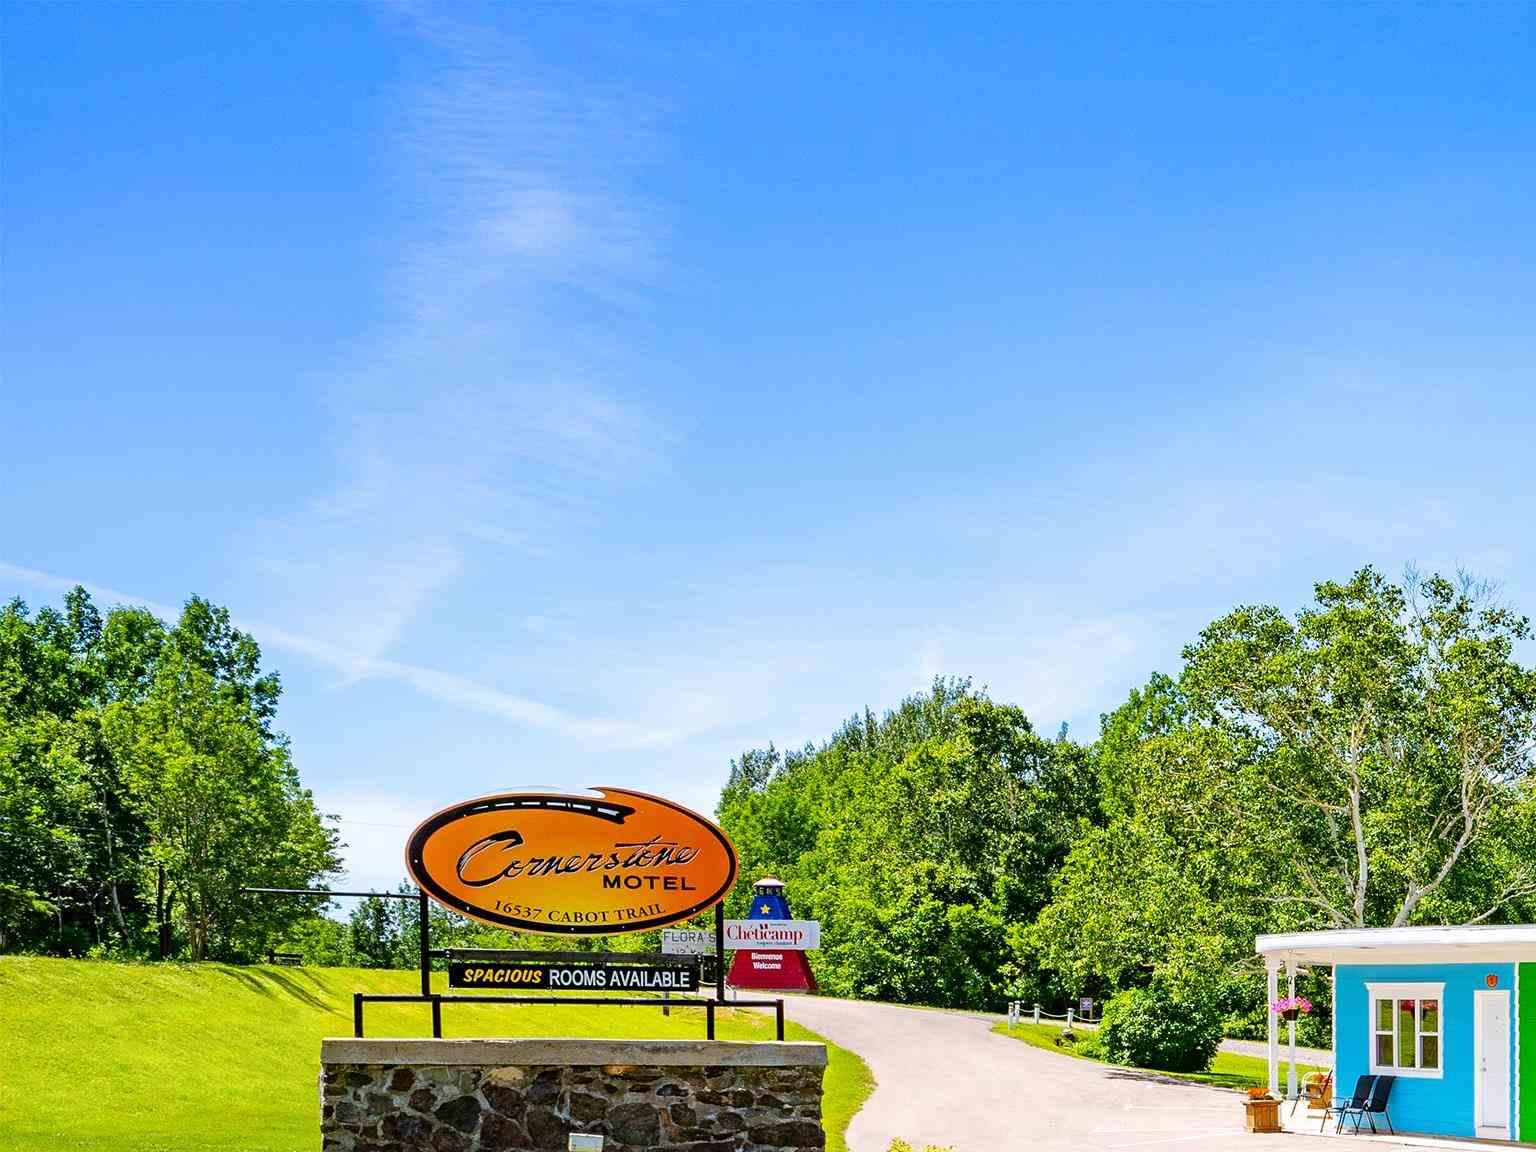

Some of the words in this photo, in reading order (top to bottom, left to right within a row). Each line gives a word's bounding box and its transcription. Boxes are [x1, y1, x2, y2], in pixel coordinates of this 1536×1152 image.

[456, 830, 701, 888] Cornerstone
[602, 874, 697, 891] MOTEL
[493, 900, 543, 921] 16537
[547, 909, 610, 923] CABOT
[615, 902, 666, 920] TRAIL
[463, 968, 543, 984] SPACIOUS
[550, 969, 606, 987] ROOMS
[609, 970, 691, 988] AVAILABLE
